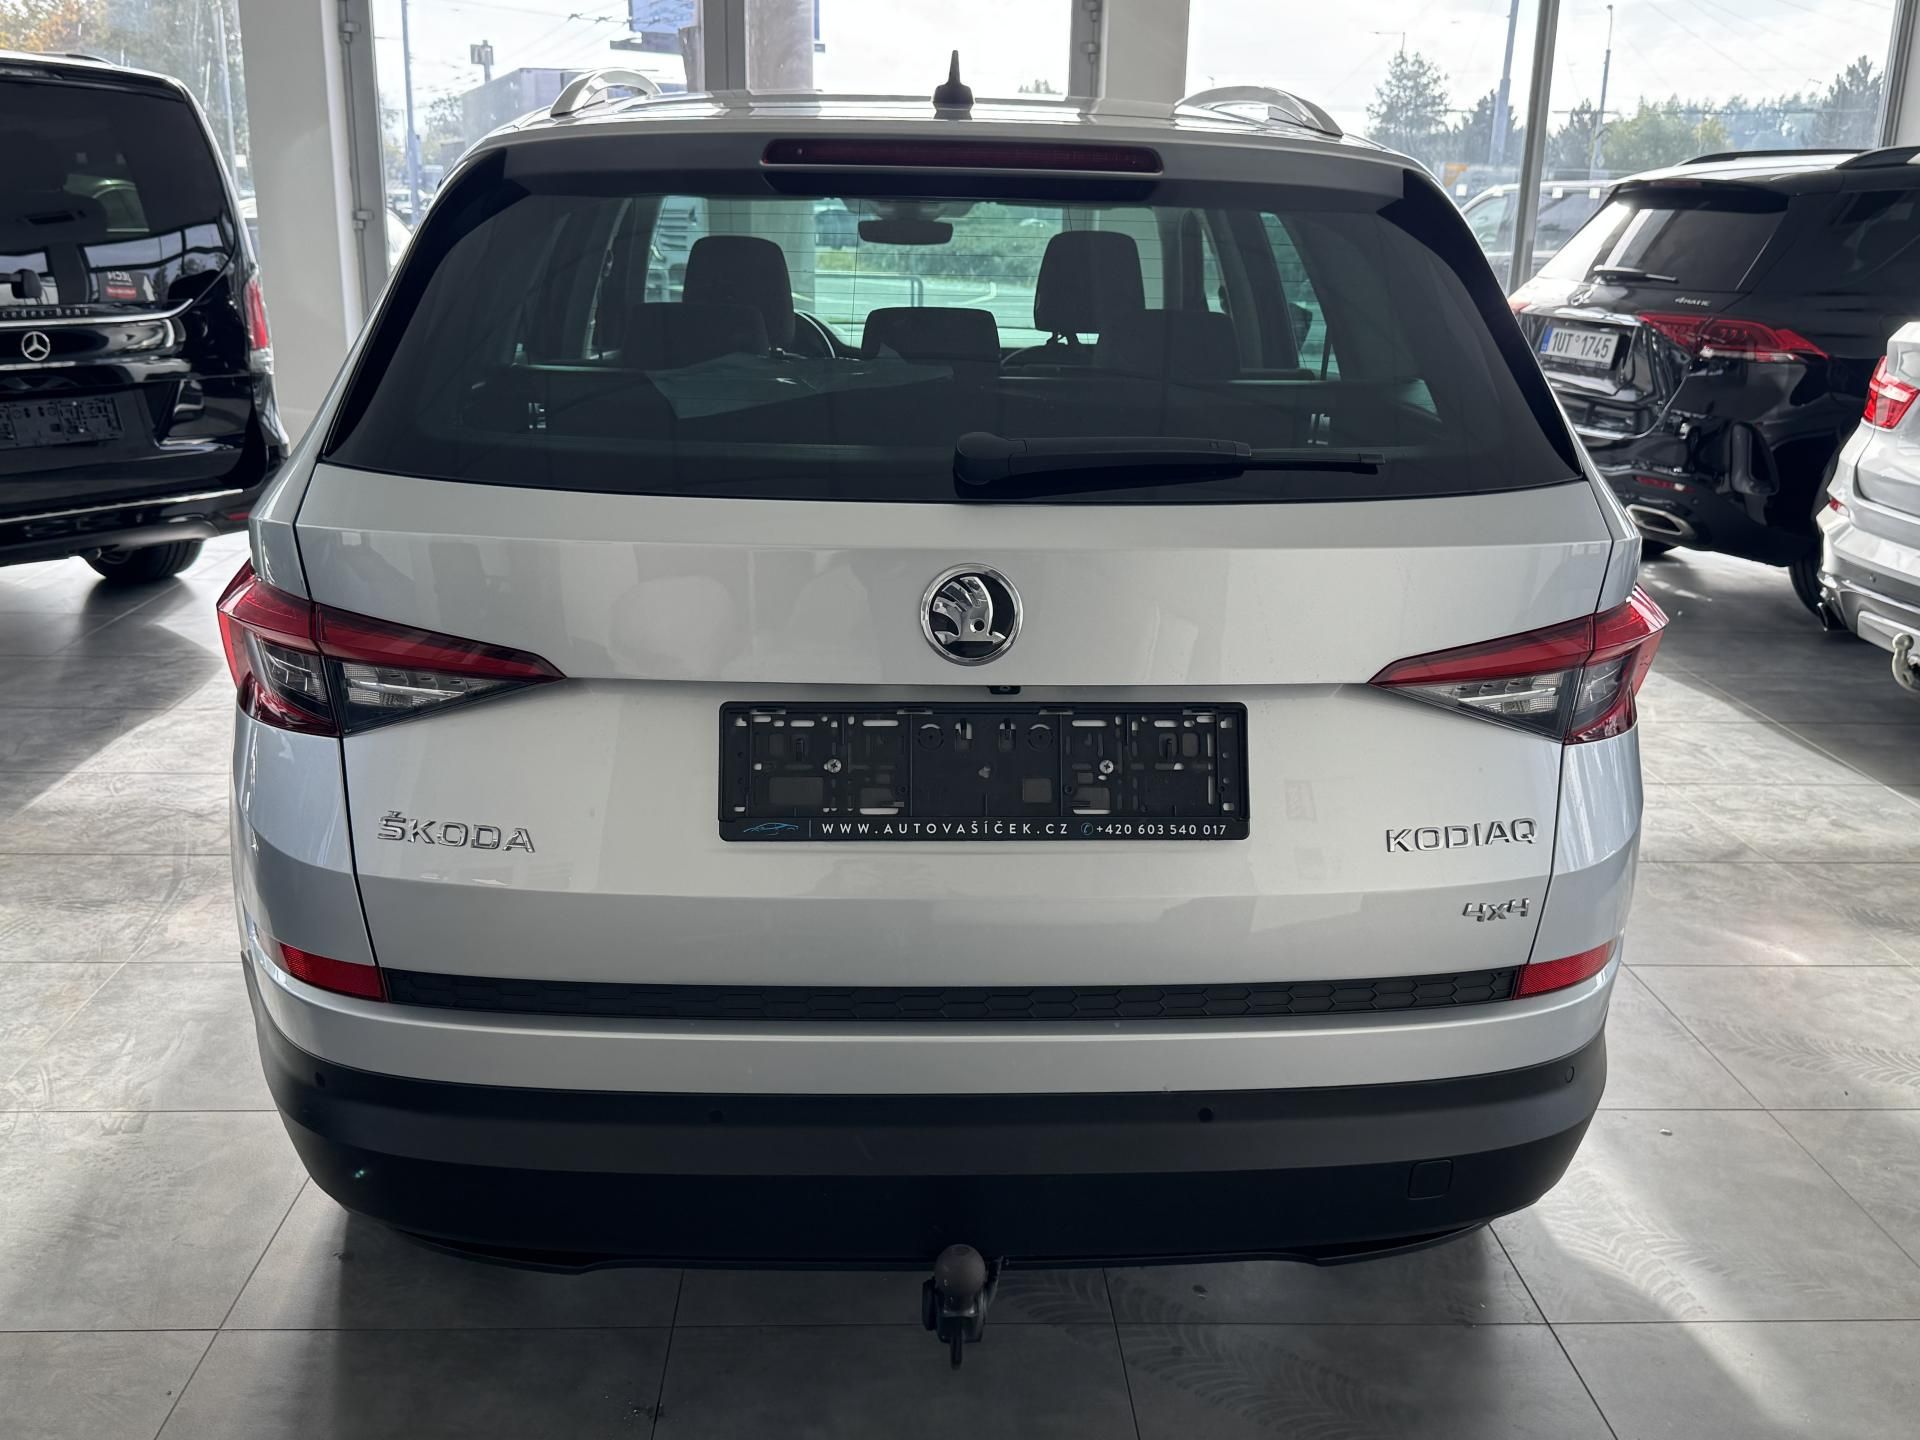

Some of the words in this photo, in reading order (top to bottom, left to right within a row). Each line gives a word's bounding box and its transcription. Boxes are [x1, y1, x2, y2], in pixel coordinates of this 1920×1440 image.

[1551, 331, 1574, 353] 1UT
[1581, 335, 1612, 359] 1745
[377, 810, 536, 853] ŠKODA
[821, 820, 1068, 835] WWW.AUTOVAŠÍČEK.CZ
[1096, 824, 1132, 835] +420
[1138, 824, 1165, 835] 603
[1170, 824, 1197, 835] 540
[1203, 824, 1227, 836] 017
[1386, 818, 1538, 852] KODIAQ
[1463, 897, 1530, 922] 4x4
